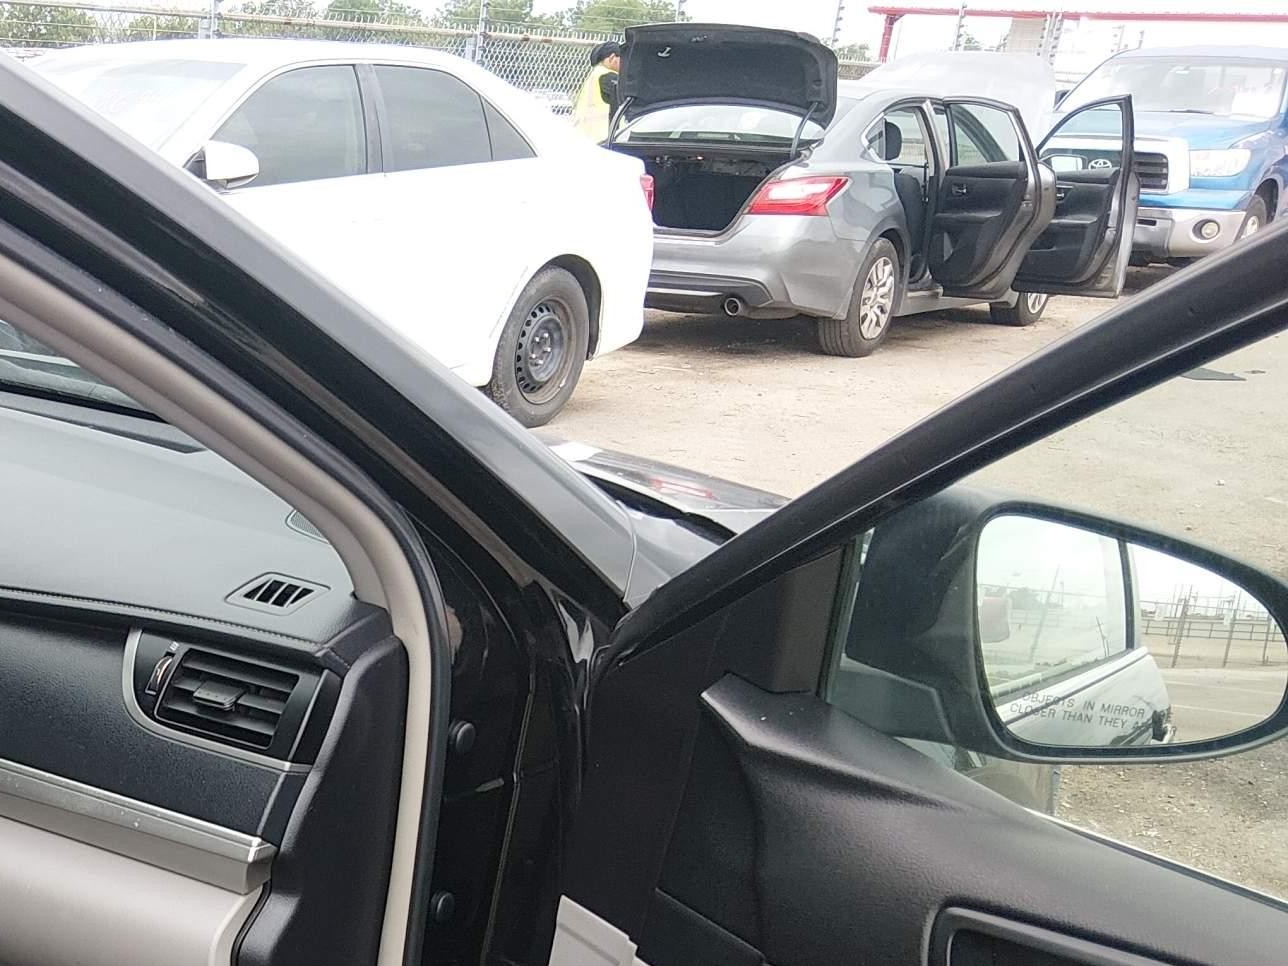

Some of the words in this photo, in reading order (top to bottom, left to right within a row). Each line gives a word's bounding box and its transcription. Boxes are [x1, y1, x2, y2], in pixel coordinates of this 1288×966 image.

[1082, 700, 1096, 711] IN
[1100, 703, 1145, 719] MIRROR
[1061, 710, 1092, 724] THAN
[1098, 716, 1128, 729] THEY
